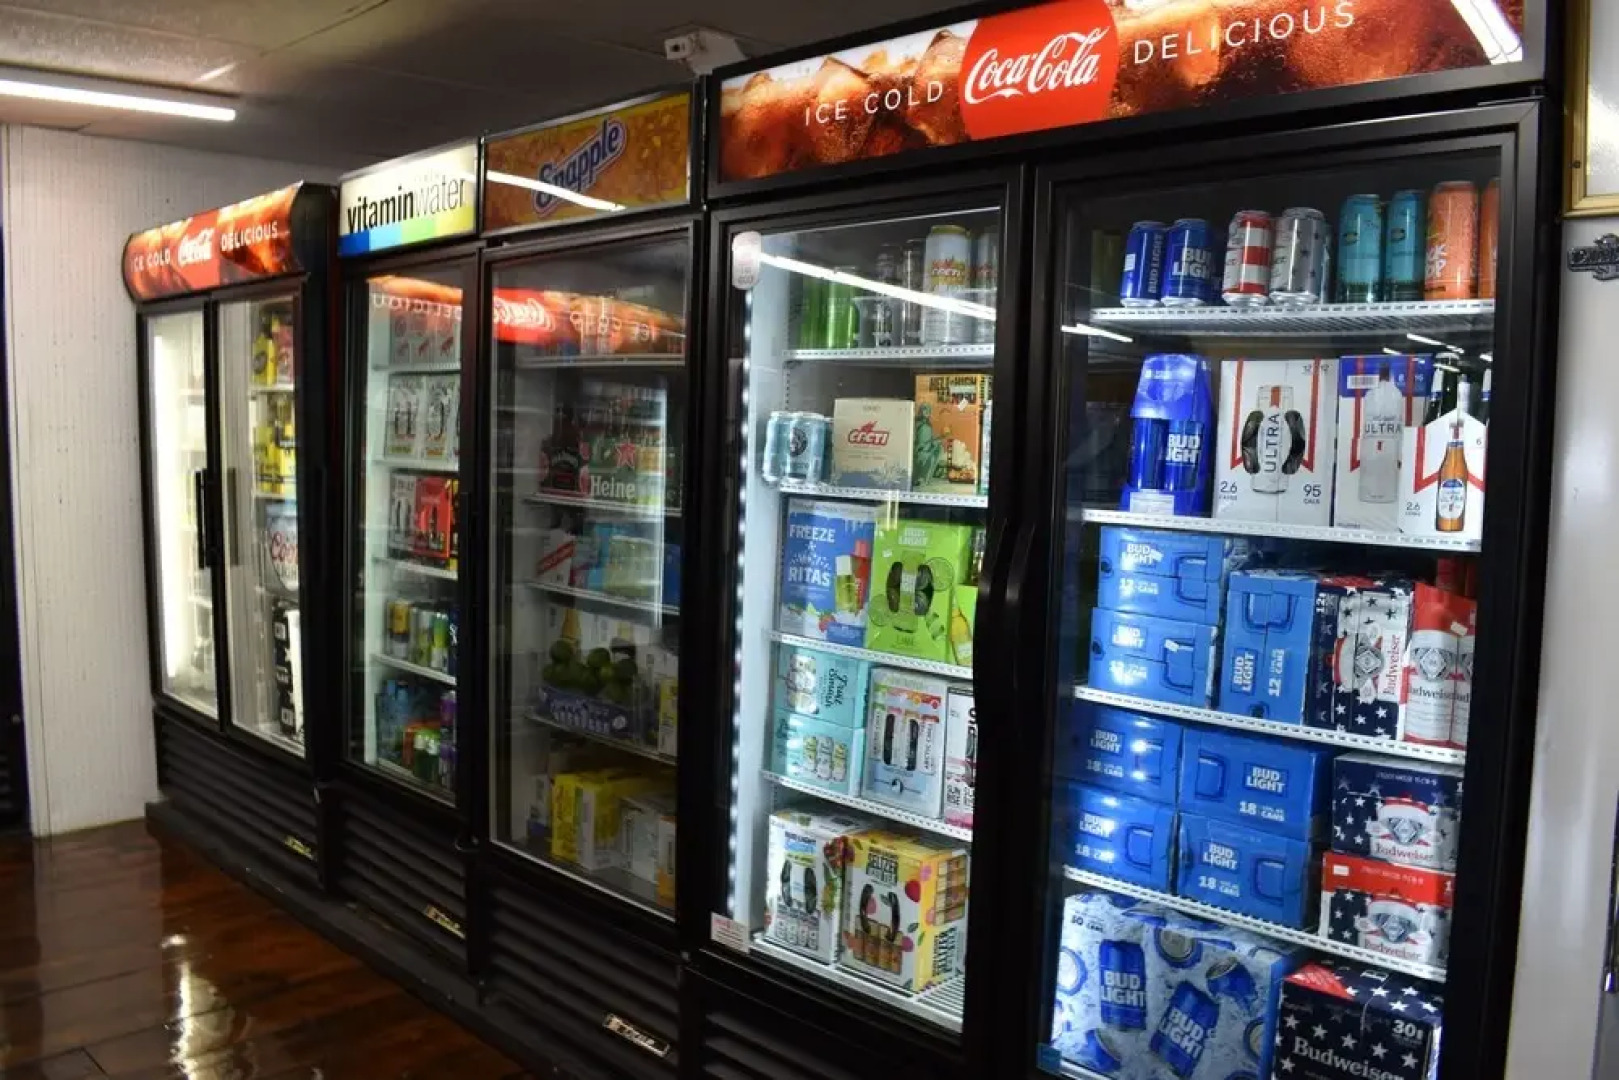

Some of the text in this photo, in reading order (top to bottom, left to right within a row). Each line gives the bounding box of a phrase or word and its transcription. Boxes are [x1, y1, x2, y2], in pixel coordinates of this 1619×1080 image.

[1134, 0, 1356, 64] DELICIOUS
[804, 81, 944, 126] ICE COLD
[535, 118, 626, 208] Snapple
[221, 221, 278, 252] DELICIOUS
[1168, 428, 1201, 448] BUD
[1264, 412, 1280, 474] ULTRA
[1302, 484, 1322, 498] 95
[788, 524, 836, 543] FREEZE
[1126, 543, 1151, 555] BUD
[787, 566, 831, 587] RITAS
[1232, 655, 1245, 685] BUD
[1241, 651, 1255, 692] LIGHT
[1268, 678, 1281, 697] 12
[1095, 729, 1118, 742] BUD
[1089, 738, 1121, 754] LIGHT
[1252, 766, 1281, 782] BUD
[1245, 775, 1286, 793] LIGHT
[1239, 801, 1258, 815] 18
[1208, 843, 1235, 859] BUD
[1202, 851, 1238, 871] LIGHT
[1198, 875, 1217, 890] 18
[1103, 970, 1141, 988] BUD
[1100, 985, 1147, 1008] LIGHT
[1167, 1006, 1205, 1041] BUD
[1393, 1018, 1415, 1037] 30
[1159, 1014, 1203, 1059] LIGHT
